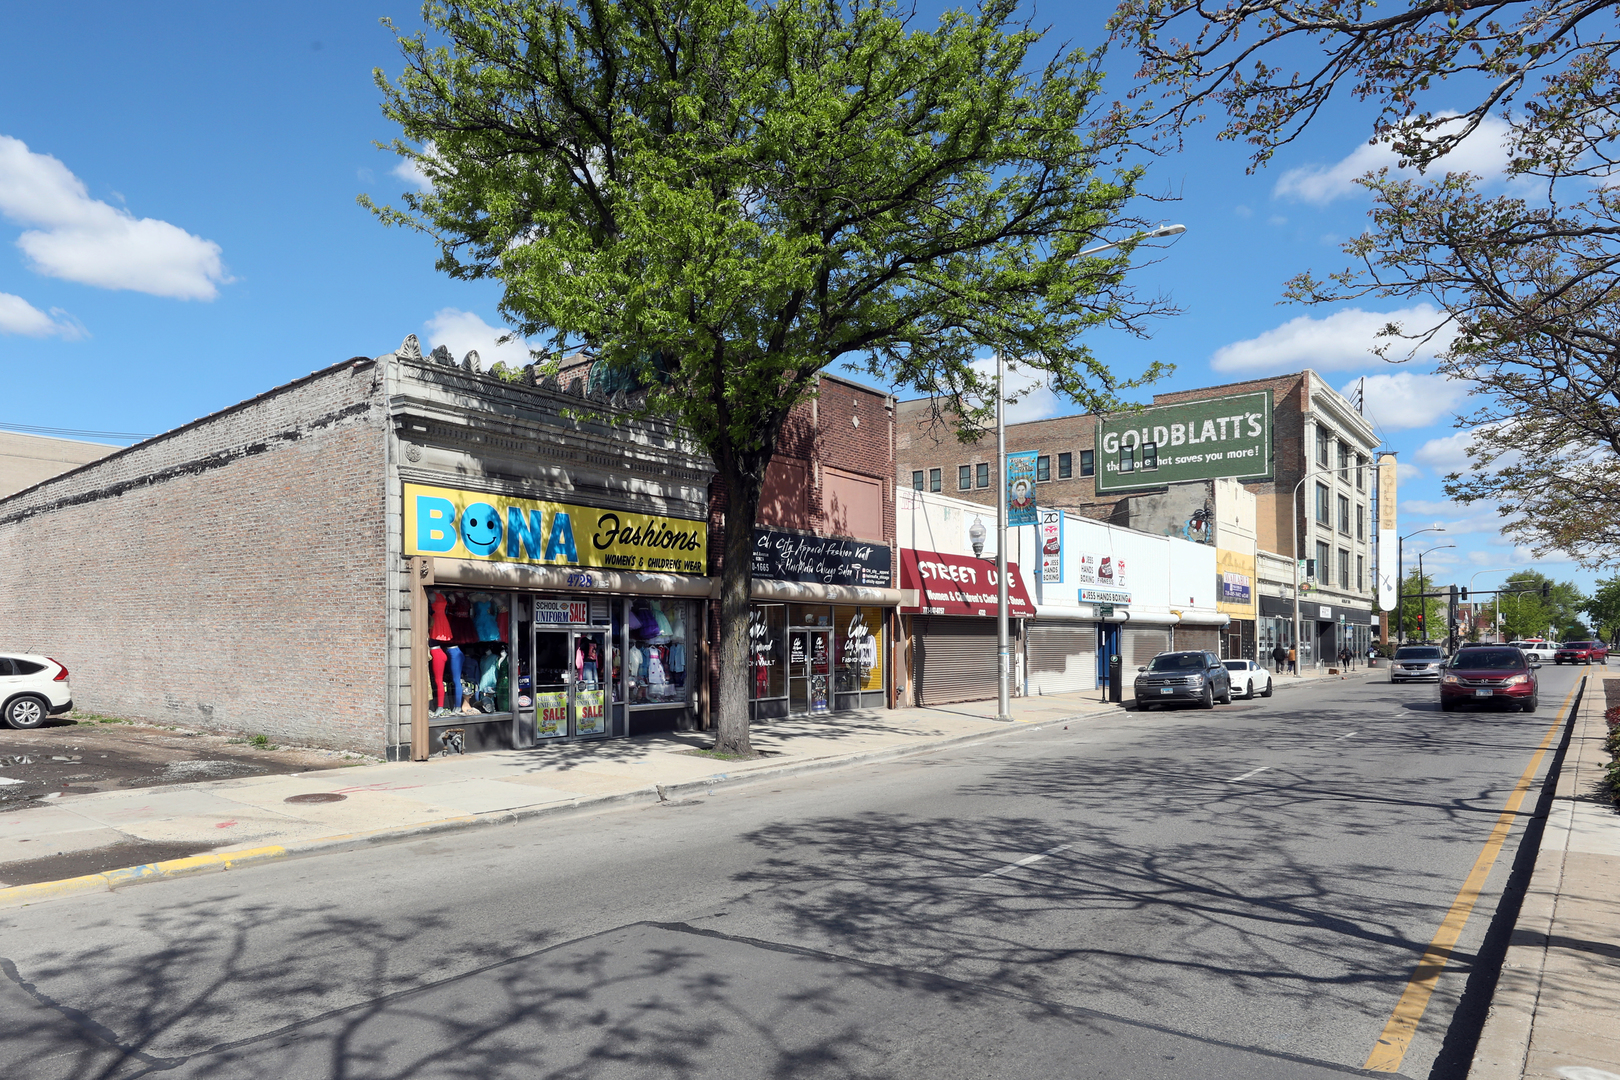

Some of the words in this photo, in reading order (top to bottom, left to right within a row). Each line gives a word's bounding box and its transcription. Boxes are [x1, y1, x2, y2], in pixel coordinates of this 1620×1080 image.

[1103, 412, 1262, 453] GOLDBLATT'S
[1154, 456, 1172, 466] hat
[1174, 454, 1202, 464] saves
[1205, 452, 1222, 463] you
[1227, 446, 1259, 459] more!
[1044, 512, 1058, 524] ZC
[416, 495, 579, 563] BONA
[593, 513, 700, 551] Fashions
[776, 537, 794, 558] City
[794, 538, 826, 560] Apparel
[855, 546, 874, 560] Vault
[604, 554, 636, 566] WOMEN'S
[638, 557, 644, 567] &
[648, 558, 682, 570] CHILDREN'S
[684, 560, 702, 572] WEAR
[1081, 565, 1094, 574] HANDS
[838, 564, 852, 576] Salon
[918, 560, 976, 584] STREET
[986, 570, 1016, 588] LIE
[567, 574, 592, 588] 4728
[1080, 574, 1095, 584] BOXING
[926, 590, 950, 600] Women
[949, 590, 956, 602] &
[954, 592, 983, 603] Children's
[1009, 596, 1026, 606] Shoes
[1086, 591, 1096, 600] JESS
[1097, 592, 1112, 601] HANDS
[1112, 593, 1129, 602] BOXING
[536, 602, 560, 610] SCHOOL
[570, 602, 586, 622] SALE
[536, 611, 569, 622] UNIFORM
[543, 707, 566, 720] SALE
[582, 705, 603, 718] SALE
